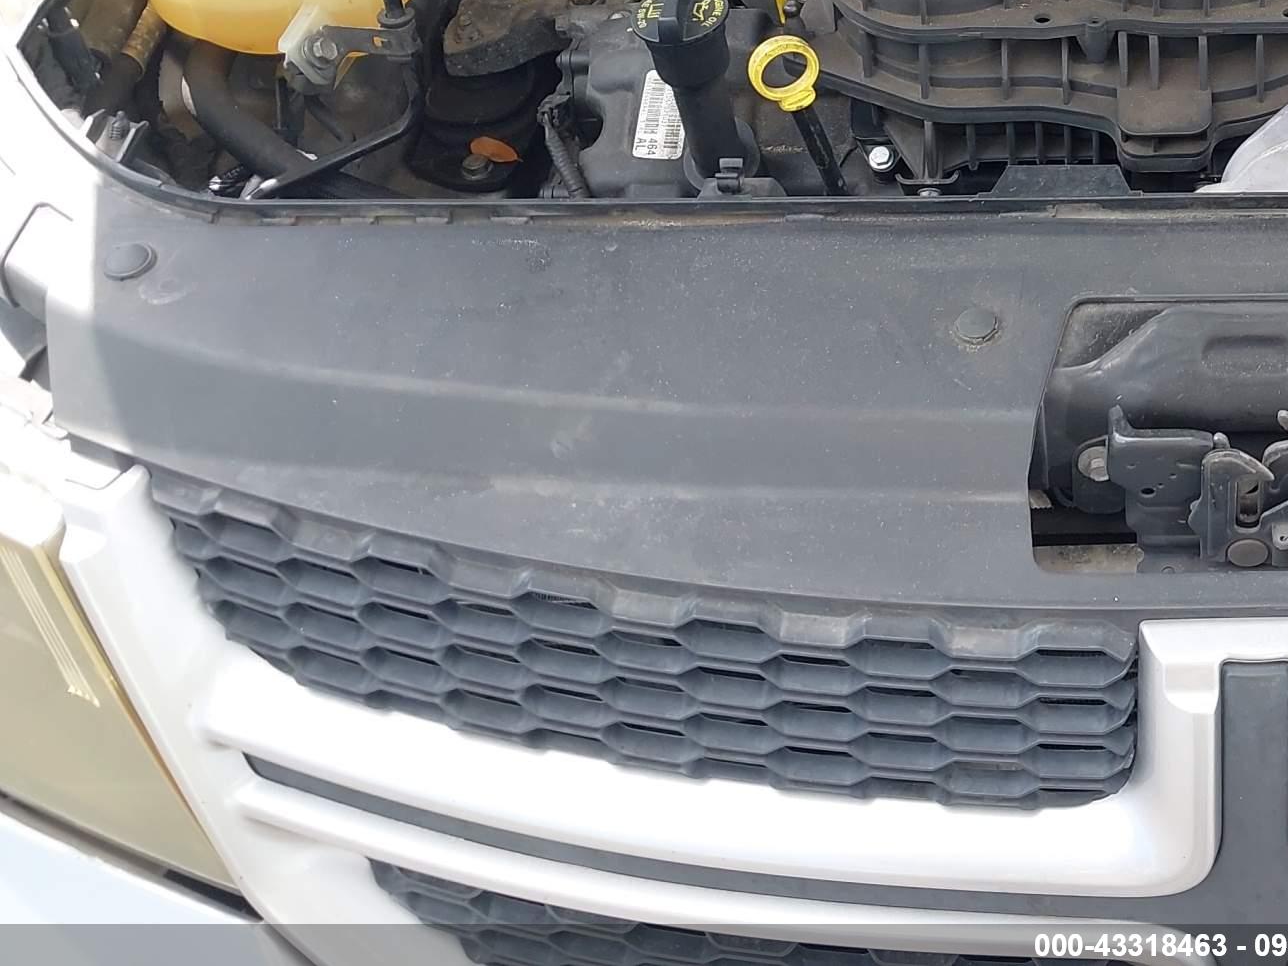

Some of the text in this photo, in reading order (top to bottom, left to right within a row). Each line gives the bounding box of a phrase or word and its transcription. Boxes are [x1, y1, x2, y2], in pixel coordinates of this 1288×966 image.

[701, 16, 718, 28] OIL
[635, 137, 647, 151] AL
[646, 137, 658, 155] 464
